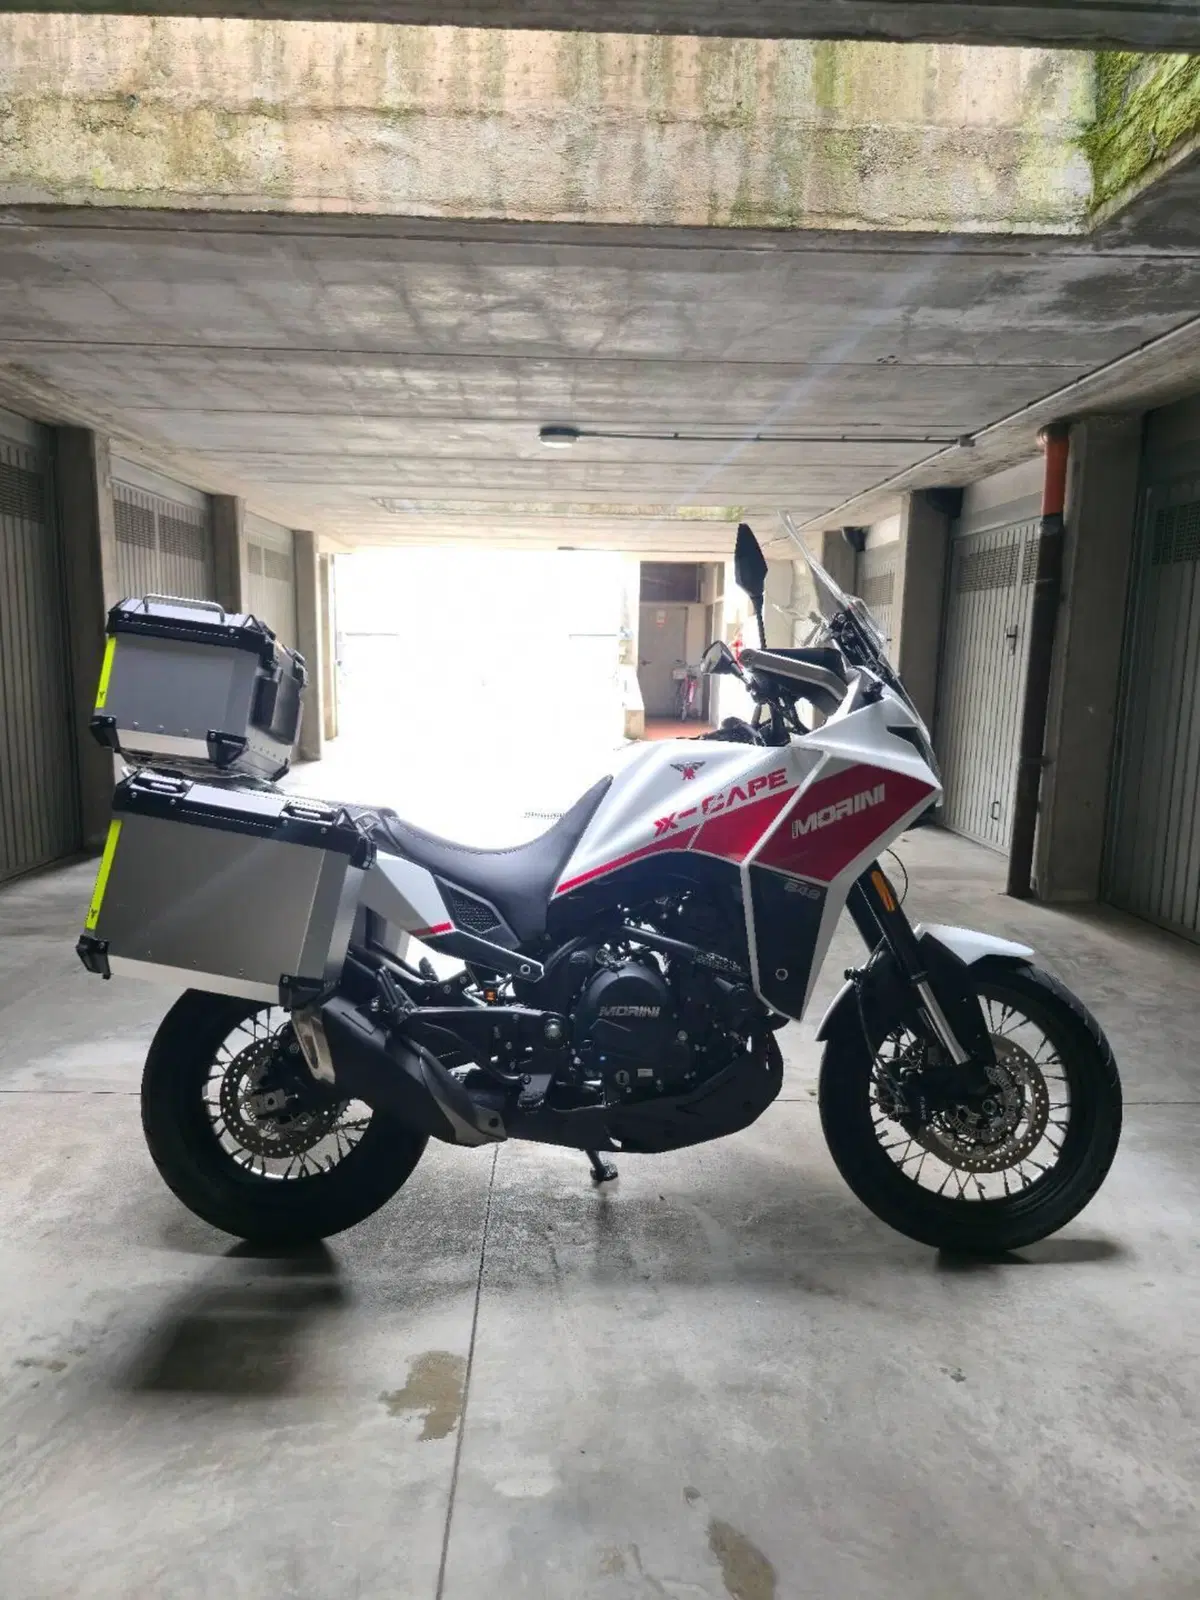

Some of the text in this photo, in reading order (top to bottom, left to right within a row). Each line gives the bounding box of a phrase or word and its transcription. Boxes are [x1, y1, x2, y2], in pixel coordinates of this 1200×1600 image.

[654, 768, 788, 838] X-CAPE
[795, 783, 885, 836] MORINI
[599, 1005, 661, 1017] MORINI
